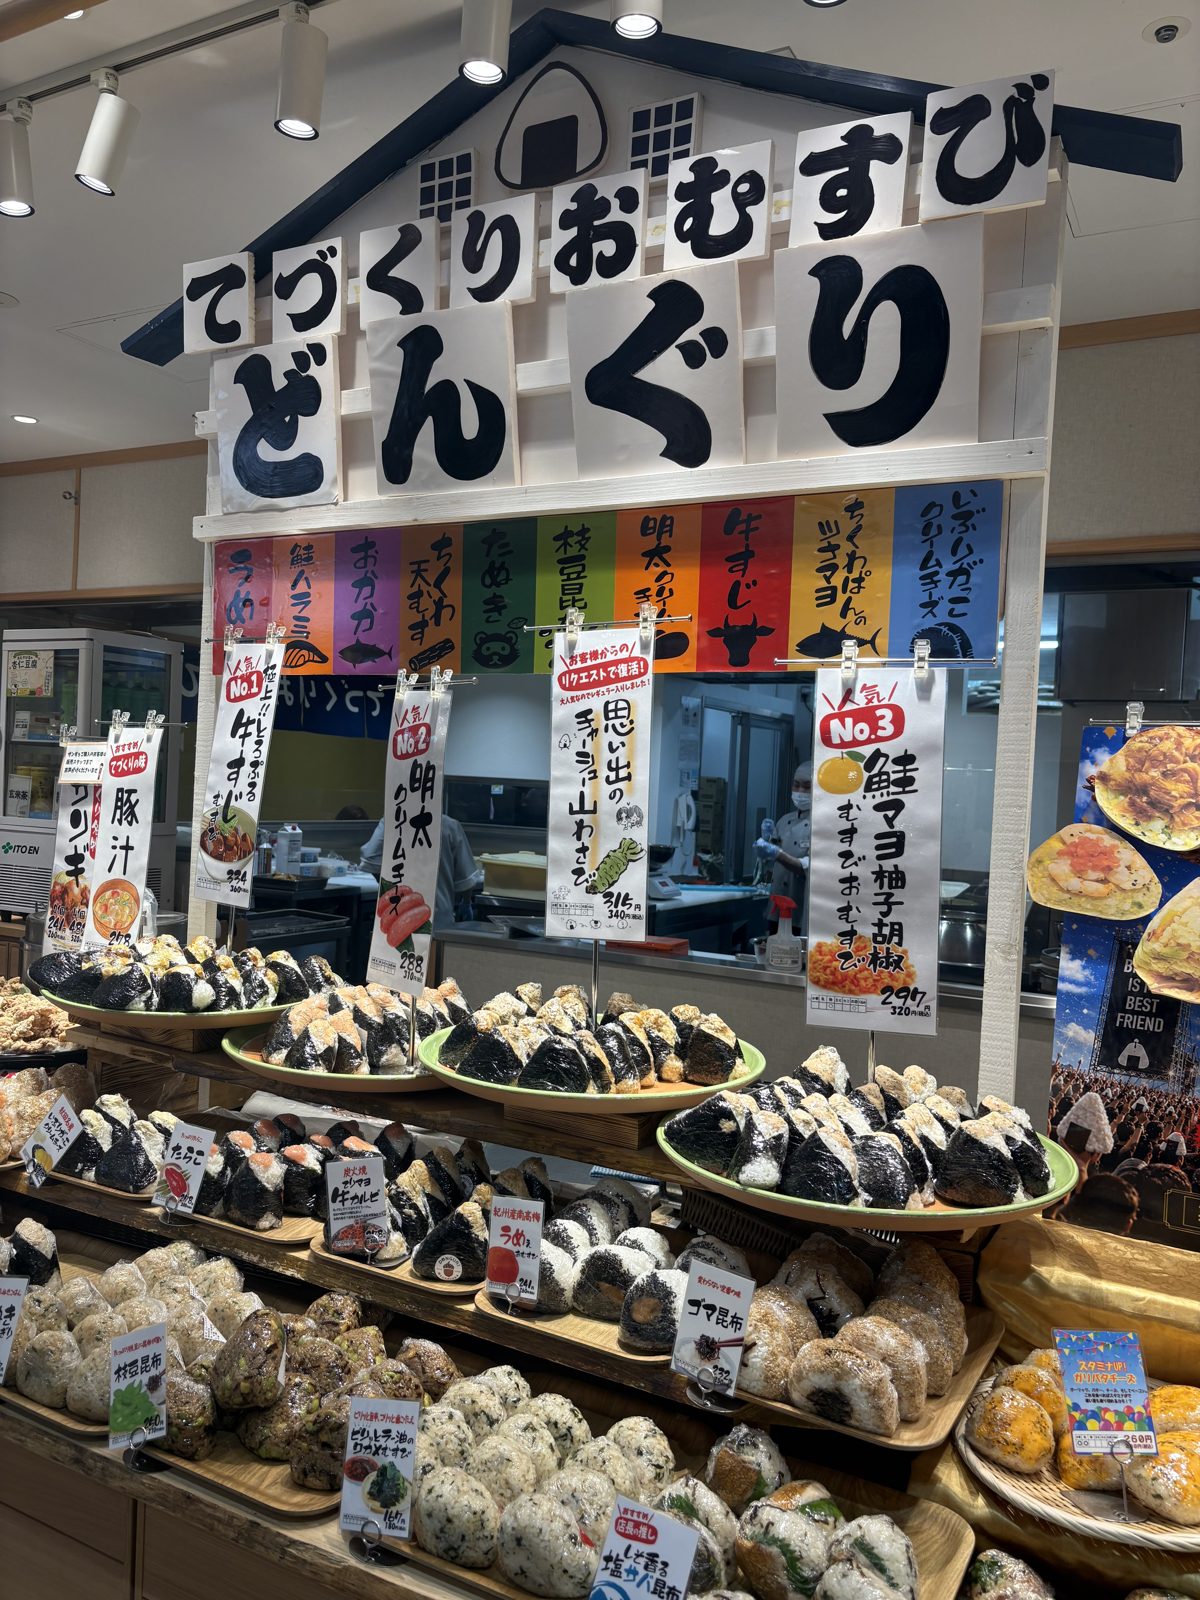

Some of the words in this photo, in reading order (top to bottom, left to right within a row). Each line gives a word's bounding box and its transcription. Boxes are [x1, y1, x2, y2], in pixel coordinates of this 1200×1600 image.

[187, 73, 1050, 344] てづくりおむすび
[233, 255, 950, 498] どんぐり
[723, 507, 762, 610] 牛すじ
[814, 520, 841, 609] ツナマヨ
[840, 497, 872, 626] ちくわぱんの
[919, 500, 944, 619] クリームチーズ
[226, 549, 255, 625] うめ
[290, 543, 315, 637] 鮭ハラミ
[350, 536, 379, 636] おかか
[431, 532, 456, 627] ちくわ
[481, 528, 514, 624] たぬき
[407, 559, 432, 646] 天むす
[233, 655, 256, 678] 人気
[568, 643, 629, 668] お客様からの
[230, 673, 259, 697] No.1
[838, 683, 884, 711] 人気
[401, 704, 423, 728] 人気
[829, 709, 895, 744] No.3
[114, 741, 140, 753] おすすめ
[396, 726, 429, 756] No.2
[603, 698, 636, 805] 思い出の
[110, 755, 147, 776] てづくりの味
[222, 708, 256, 824] 牛すじ
[8, 788, 28, 800] 玄米茶
[409, 758, 436, 849] 明太
[568, 708, 600, 888] チャーシュー山わさび
[207, 789, 224, 842] むすび
[107, 788, 140, 876] 豚汁
[13, 845, 27, 853] ITO
[28, 846, 40, 855] EN
[389, 783, 408, 916] クリームチーズ
[863, 747, 919, 973] 鮭マヨ柚子胡椒
[836, 799, 867, 972] むすびおむすび
[1128, 977, 1141, 992] IS
[1126, 995, 1160, 1013] BEST
[1116, 1013, 1164, 1032] FRIEND
[171, 1142, 205, 1166] たらこ
[344, 1165, 368, 1178] 炭火焼
[331, 1187, 380, 1207] 牛カルビ
[493, 1206, 541, 1223] 紀州産南高梅
[515, 1250, 539, 1260] おむすび
[688, 1297, 743, 1334] ゴマ昆布
[114, 1352, 162, 1383] 枝豆昆布
[1073, 1372, 1137, 1385] ガリバタチーズ
[351, 1427, 415, 1446] ピリッとラー油の
[353, 1442, 412, 1459] ワカメむすび
[1124, 1435, 1153, 1443] 260円
[617, 1519, 656, 1541] 店長の推し
[622, 1507, 650, 1522] おすすめ
[624, 1544, 669, 1579] しそ香る
